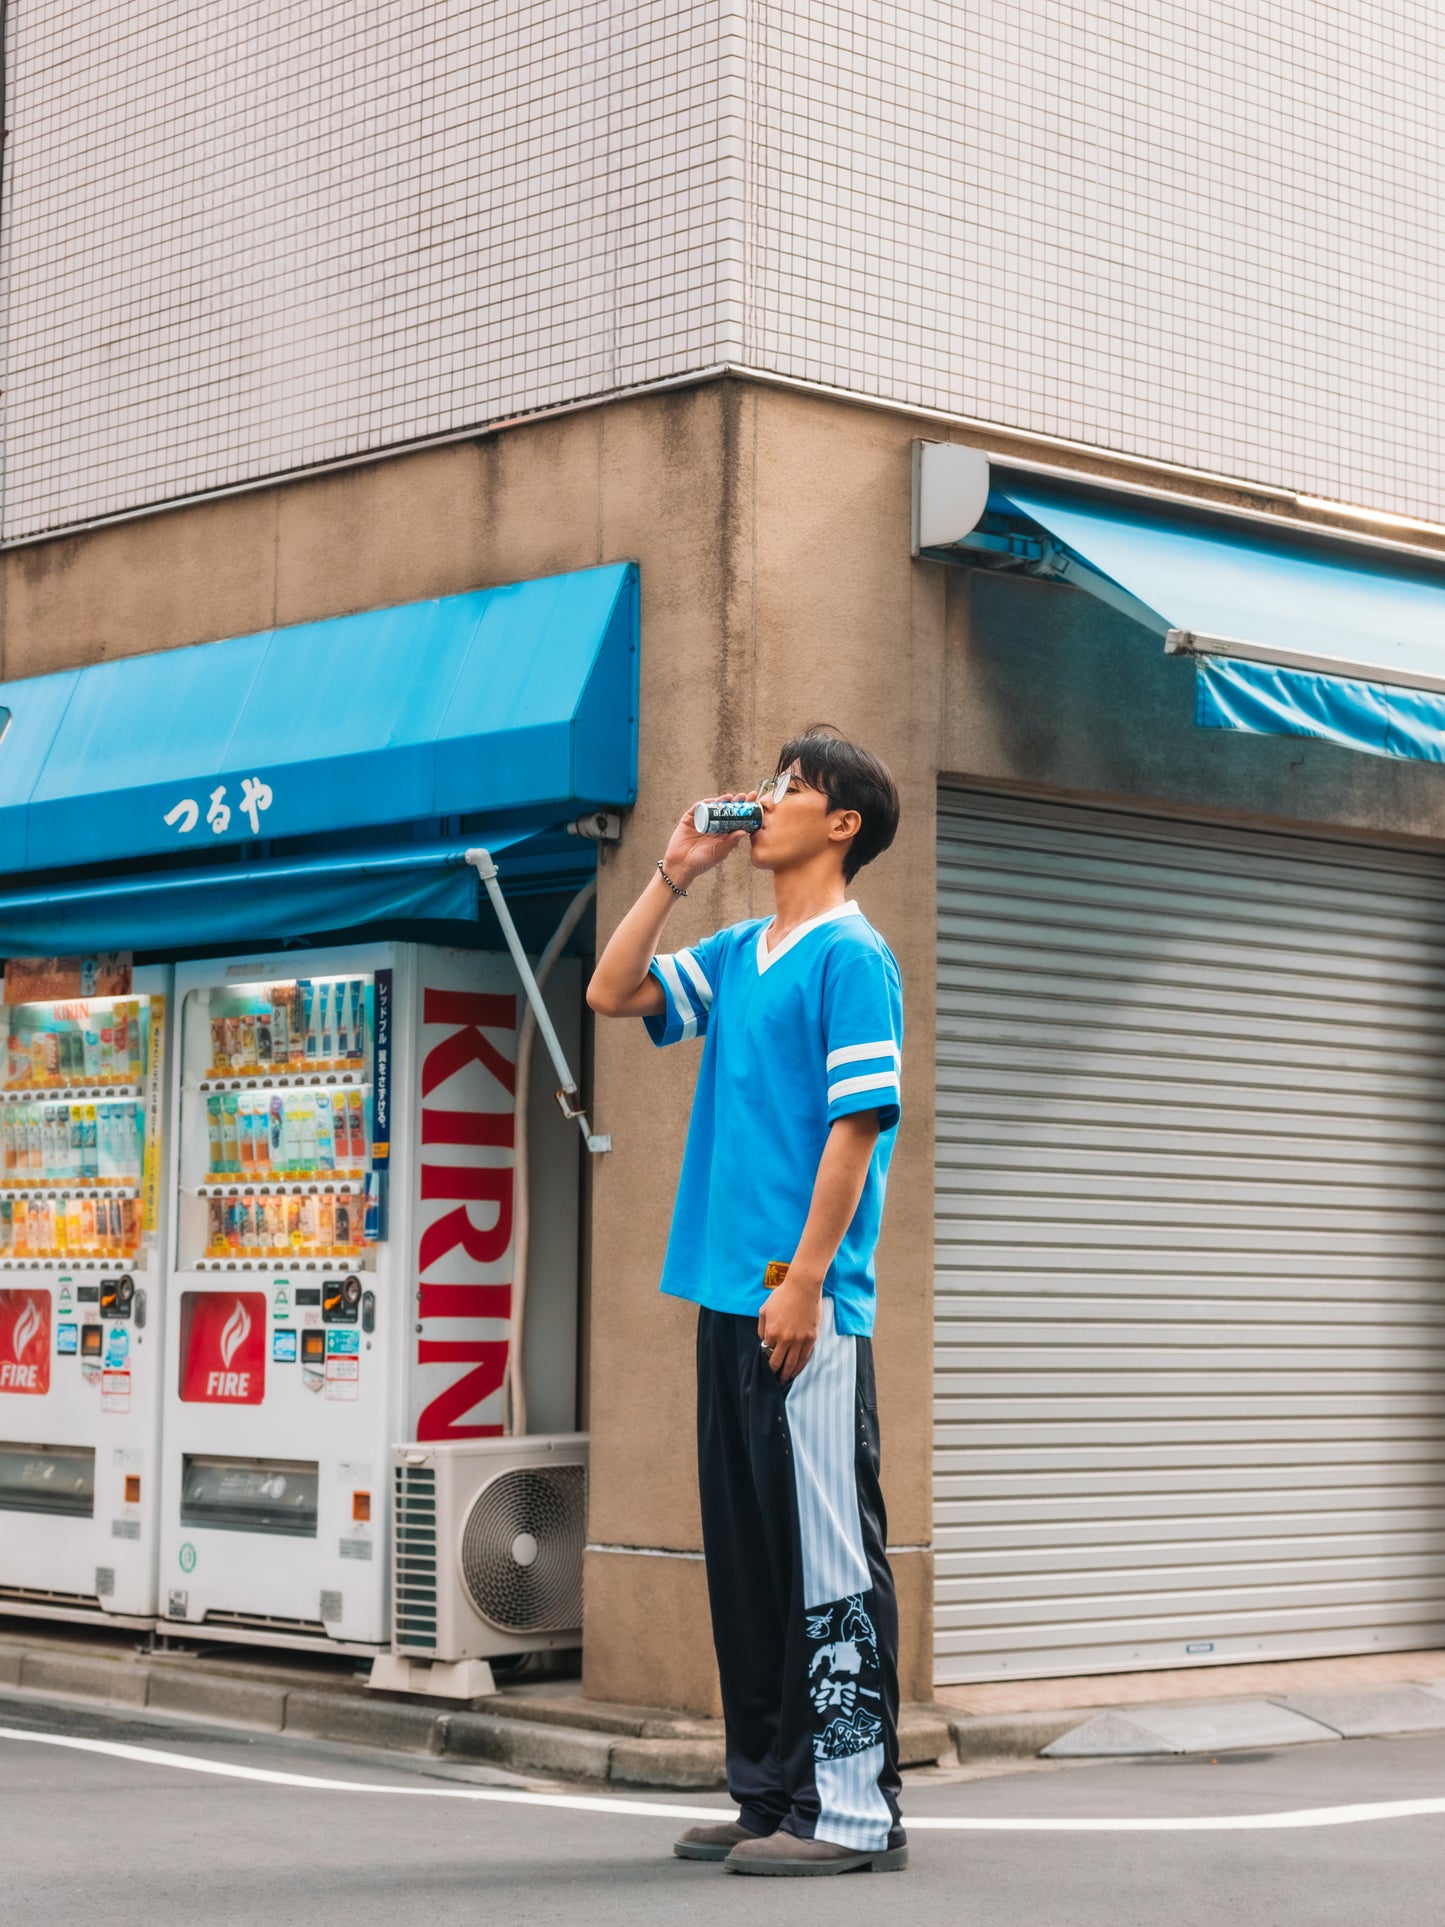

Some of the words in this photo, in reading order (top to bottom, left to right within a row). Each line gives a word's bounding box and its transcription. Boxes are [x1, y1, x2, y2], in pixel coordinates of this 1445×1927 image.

[163, 776, 273, 834] つるや
[53, 1001, 90, 1021] KIRIN
[378, 983, 388, 1045] レッドブル
[416, 986, 517, 1443] KIRIN
[0, 1364, 38, 1388] FIRE
[206, 1371, 250, 1397] FIRE
